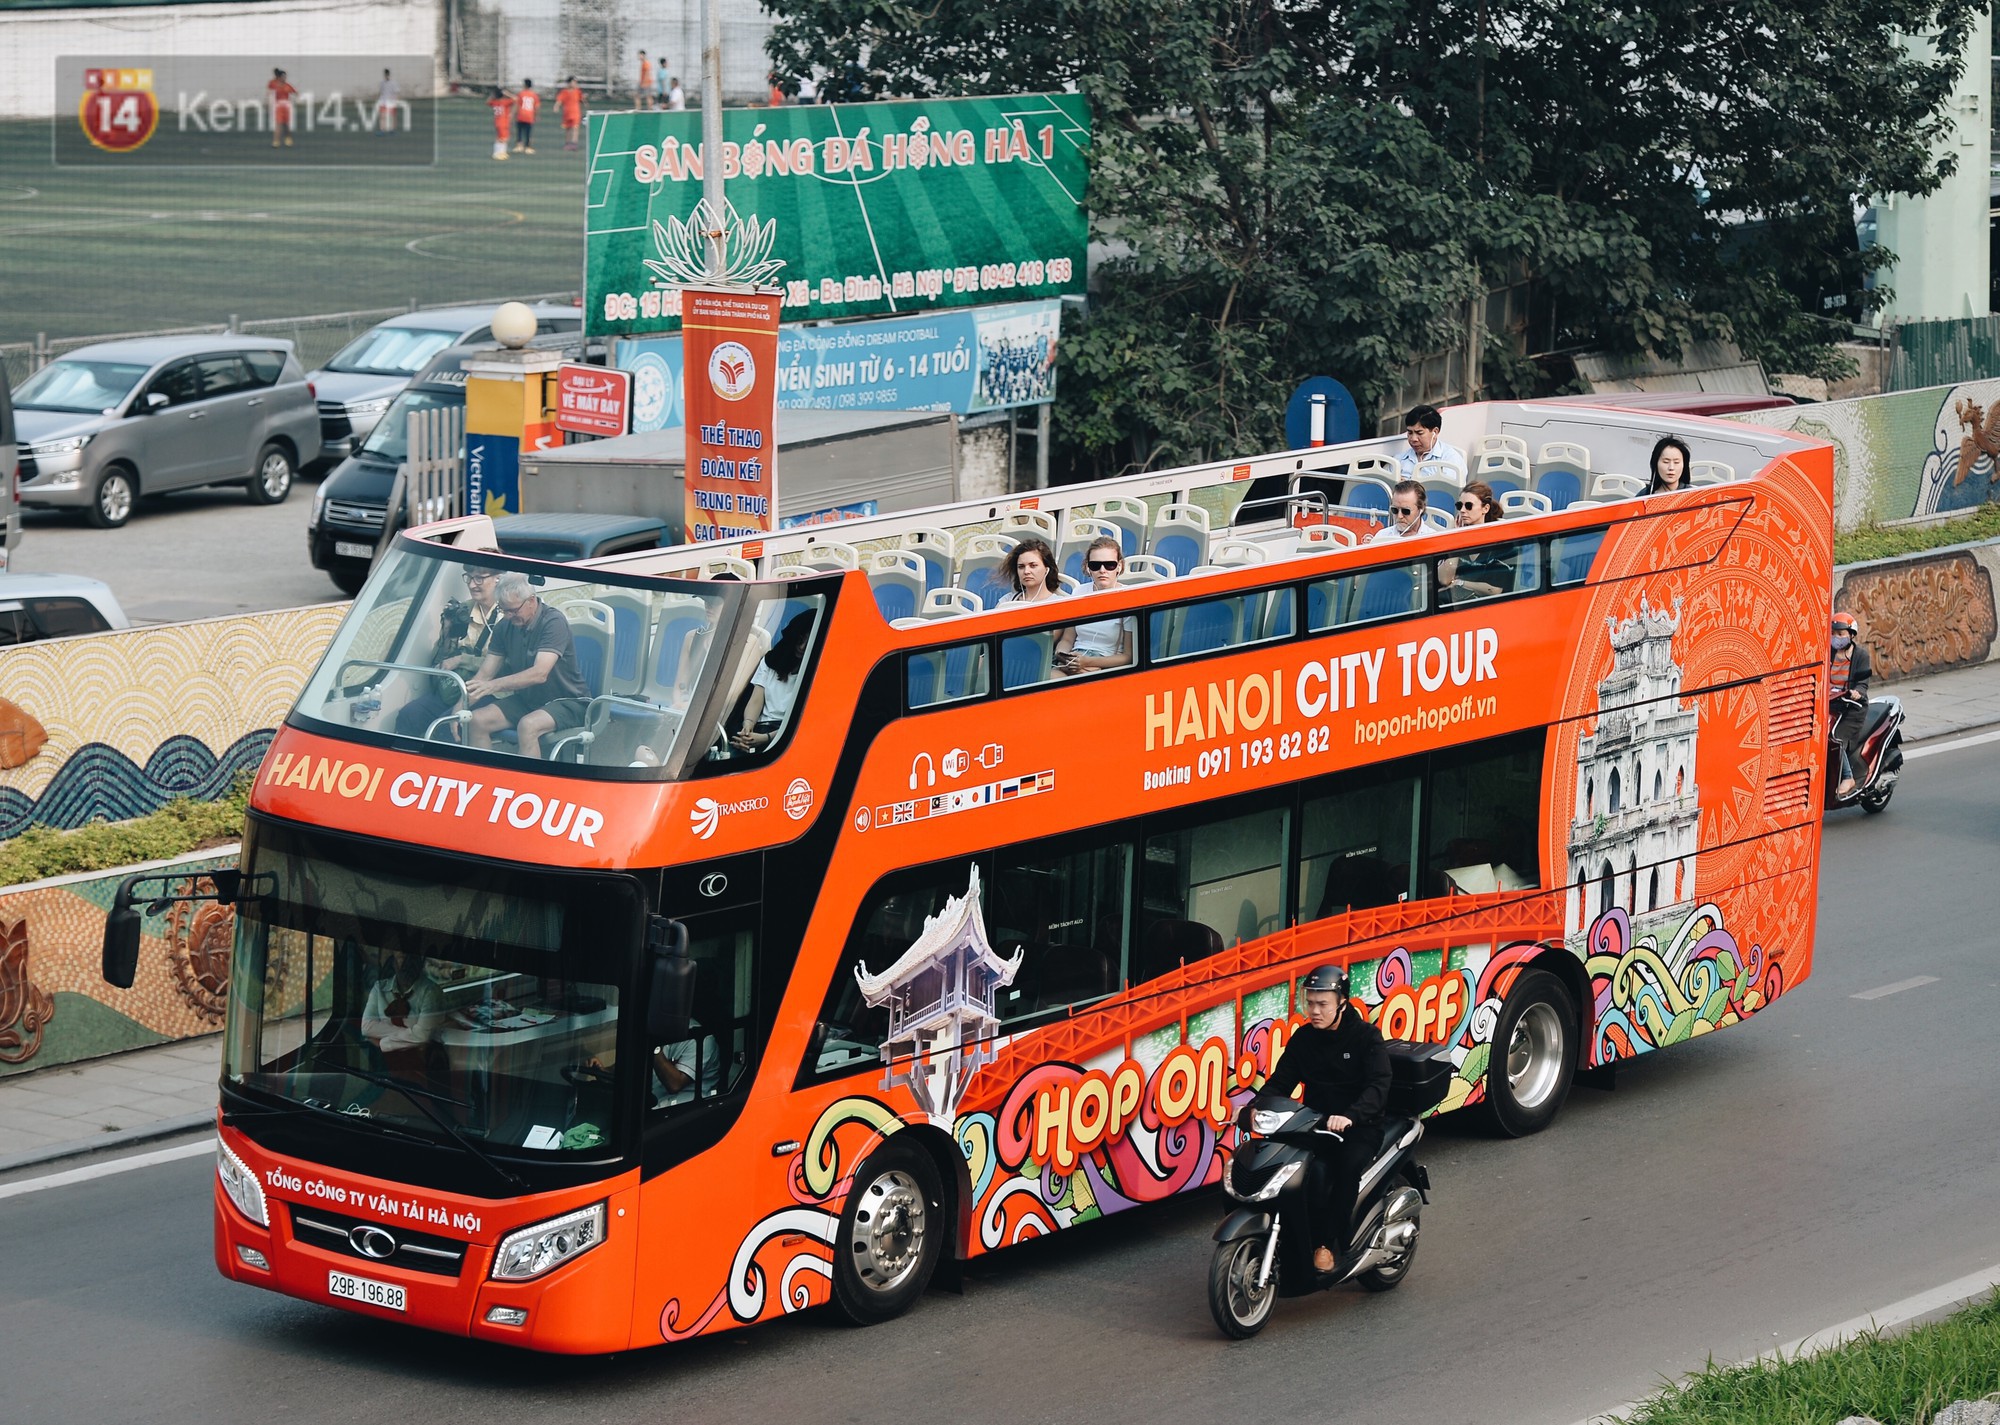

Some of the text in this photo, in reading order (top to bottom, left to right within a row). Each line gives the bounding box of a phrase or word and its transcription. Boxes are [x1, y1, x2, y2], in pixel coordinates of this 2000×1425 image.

[635, 116, 1053, 183] SÂN BÓNG ĐÁ HỒNG HÀ 1
[605, 292, 637, 321] ĐC:
[639, 291, 660, 319] 15
[786, 280, 810, 307] Xá
[820, 277, 843, 304] Ba
[844, 274, 882, 302] Đình
[892, 271, 915, 298] Hà
[916, 269, 943, 301] Nội
[953, 266, 979, 292] ĐT:
[980, 263, 1016, 290] 0942
[1016, 260, 1044, 287] 418
[1045, 258, 1073, 283] 158
[866, 331, 897, 346] DREAM
[897, 327, 940, 344] FOOTBALL
[424, 371, 470, 385] LIMO
[779, 353, 811, 391] YỂN
[815, 360, 856, 388] SINH
[858, 353, 881, 384] TỪ
[883, 358, 895, 382] 6
[909, 354, 928, 378] 14
[932, 336, 970, 375] TUỔI
[576, 394, 599, 412] MÁY
[600, 398, 620, 415] BAY
[701, 419, 762, 449] THỂ THAO
[701, 456, 762, 481] ĐOÀN KẾT
[694, 490, 732, 513] TRUNG
[736, 494, 768, 518] THỰC
[1145, 628, 1500, 751] HANOI CITY TOUR
[1354, 695, 1496, 745] hopon-hopoff.vn
[1144, 725, 1330, 791] Booking 091 193 82 82
[264, 753, 604, 848] HANOI CITY TOUR
[718, 796, 769, 817] TRANSERCO
[1381, 979, 1459, 1043] OFF
[1036, 1067, 1141, 1167] HOP
[266, 1166, 481, 1234] TỔNG CÔNG TY VẬN TẢI HÀ NỘI
[331, 1274, 404, 1308] 29B-196.88
